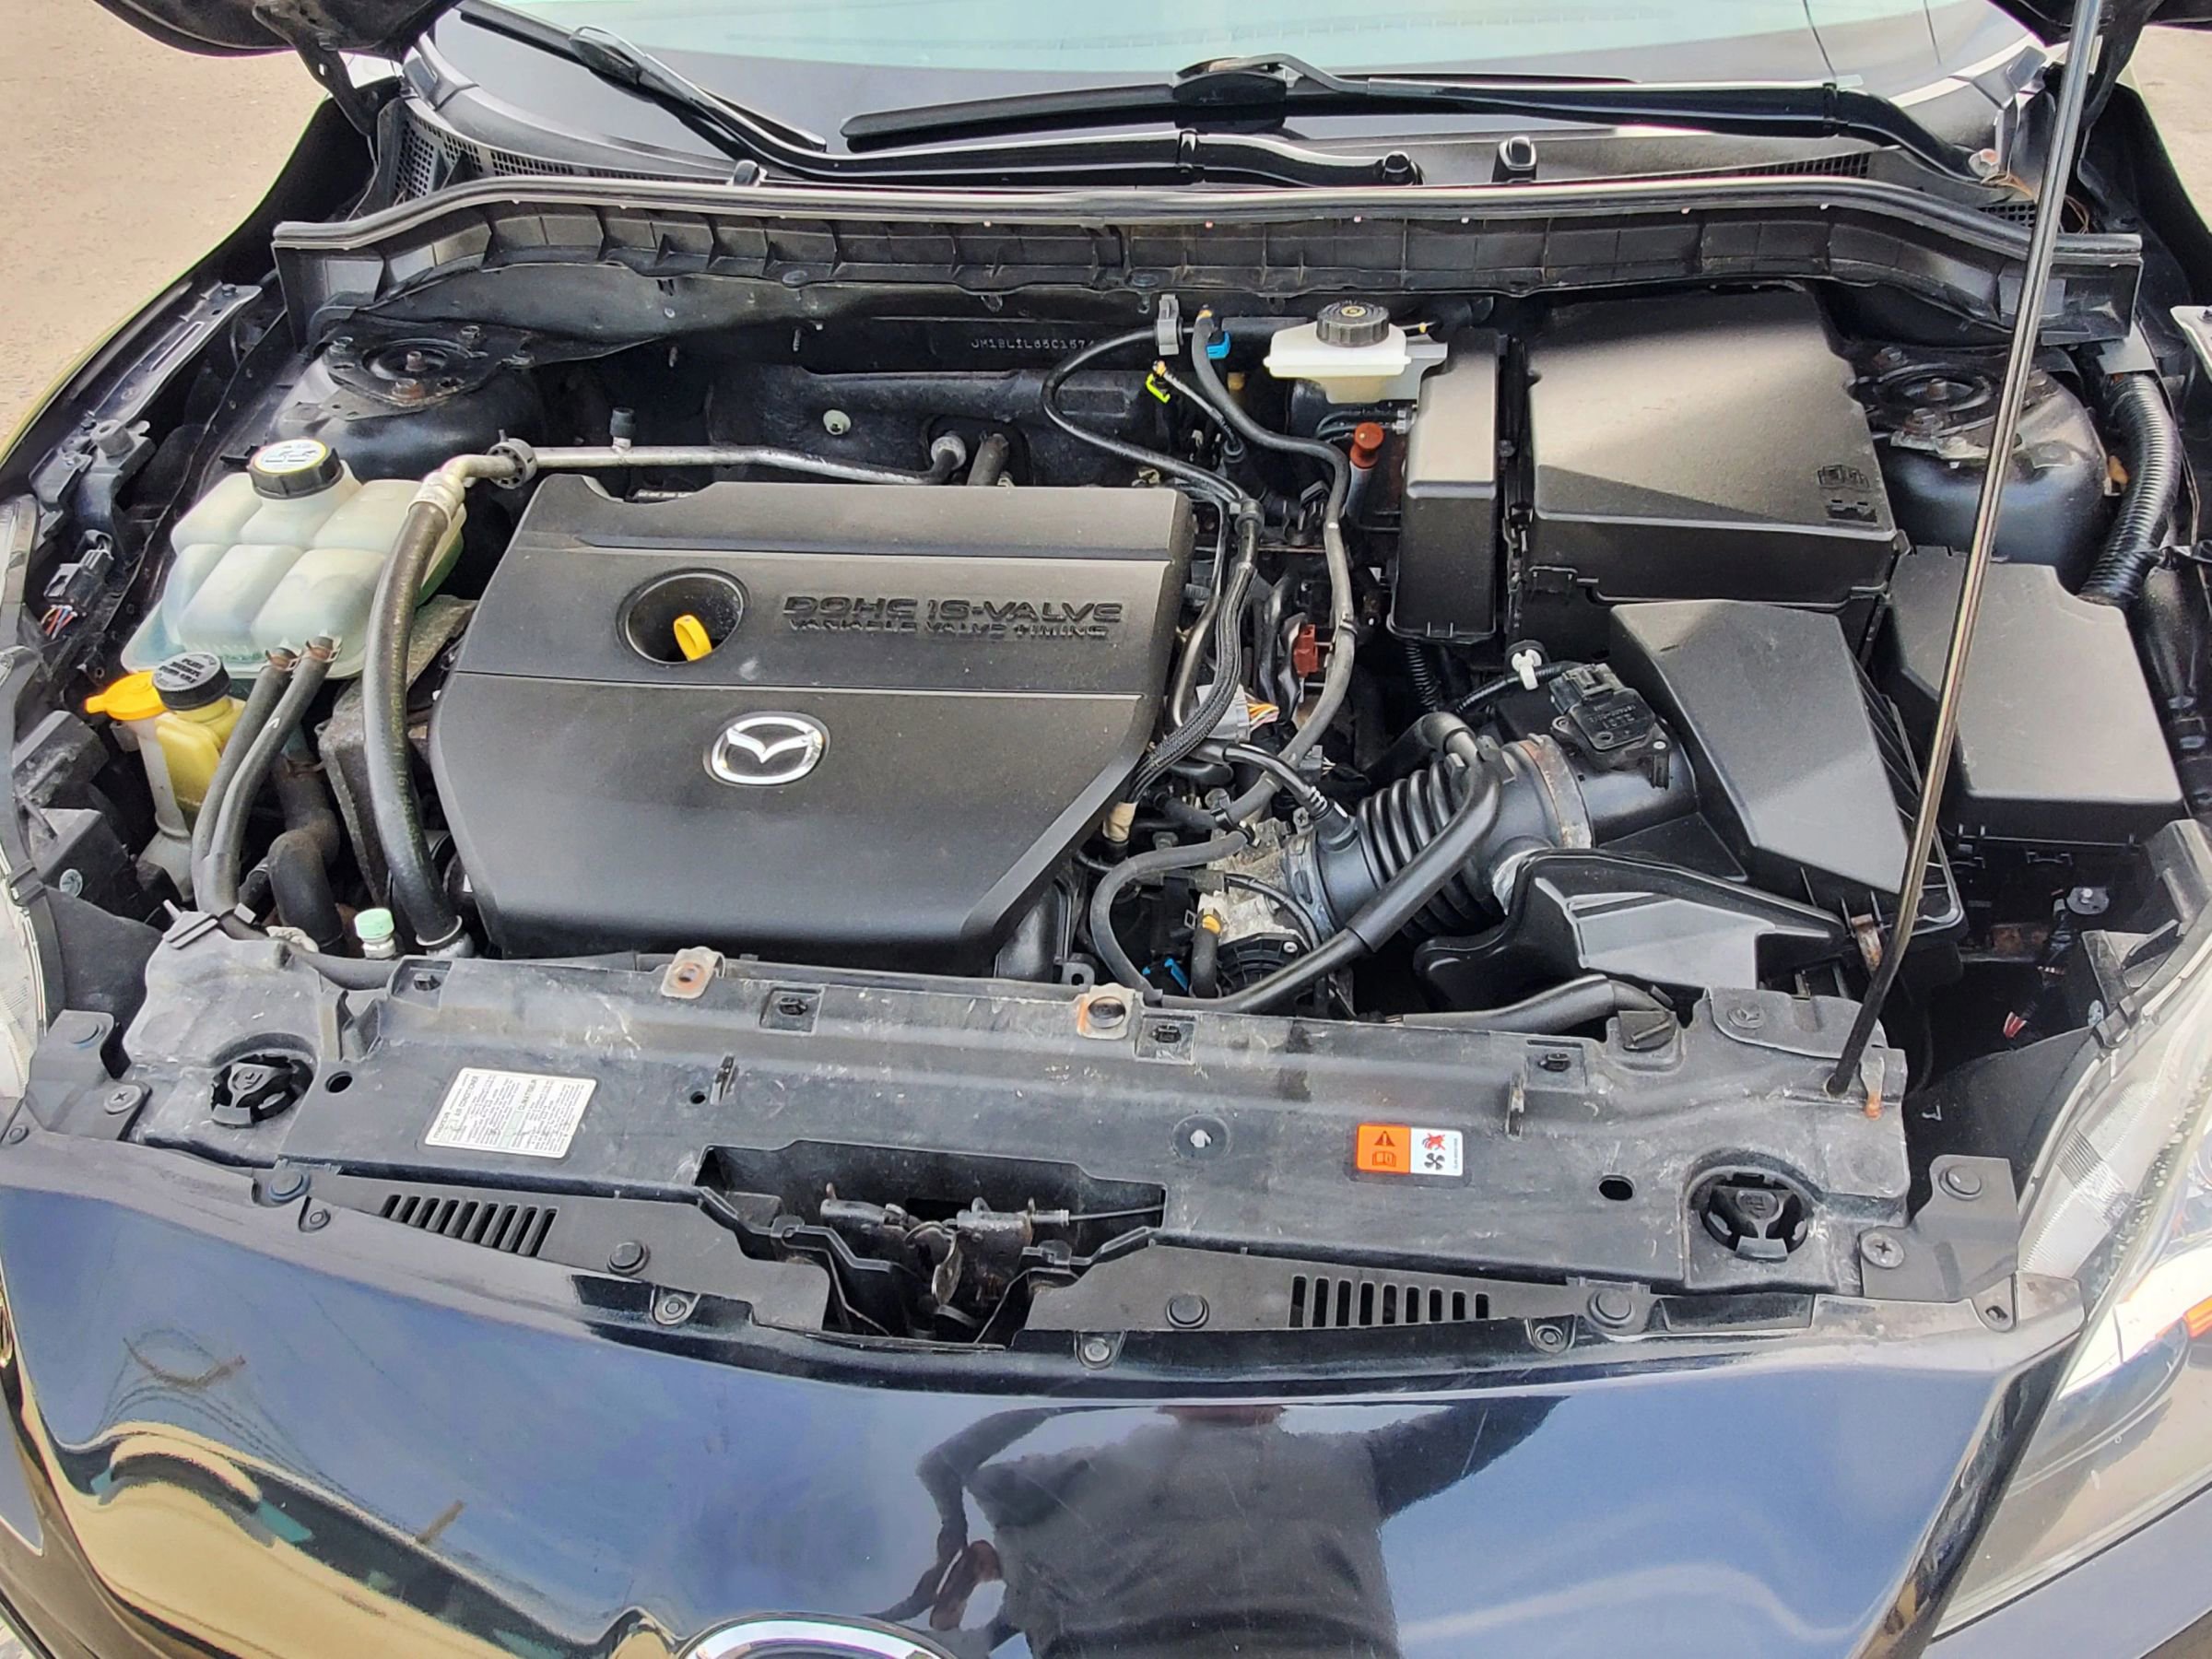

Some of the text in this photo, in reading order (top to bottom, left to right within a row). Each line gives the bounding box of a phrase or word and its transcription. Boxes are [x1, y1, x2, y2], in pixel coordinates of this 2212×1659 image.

[783, 596, 918, 618] DOHC
[788, 618, 1110, 641] VARIABLE VALVE TIMING
